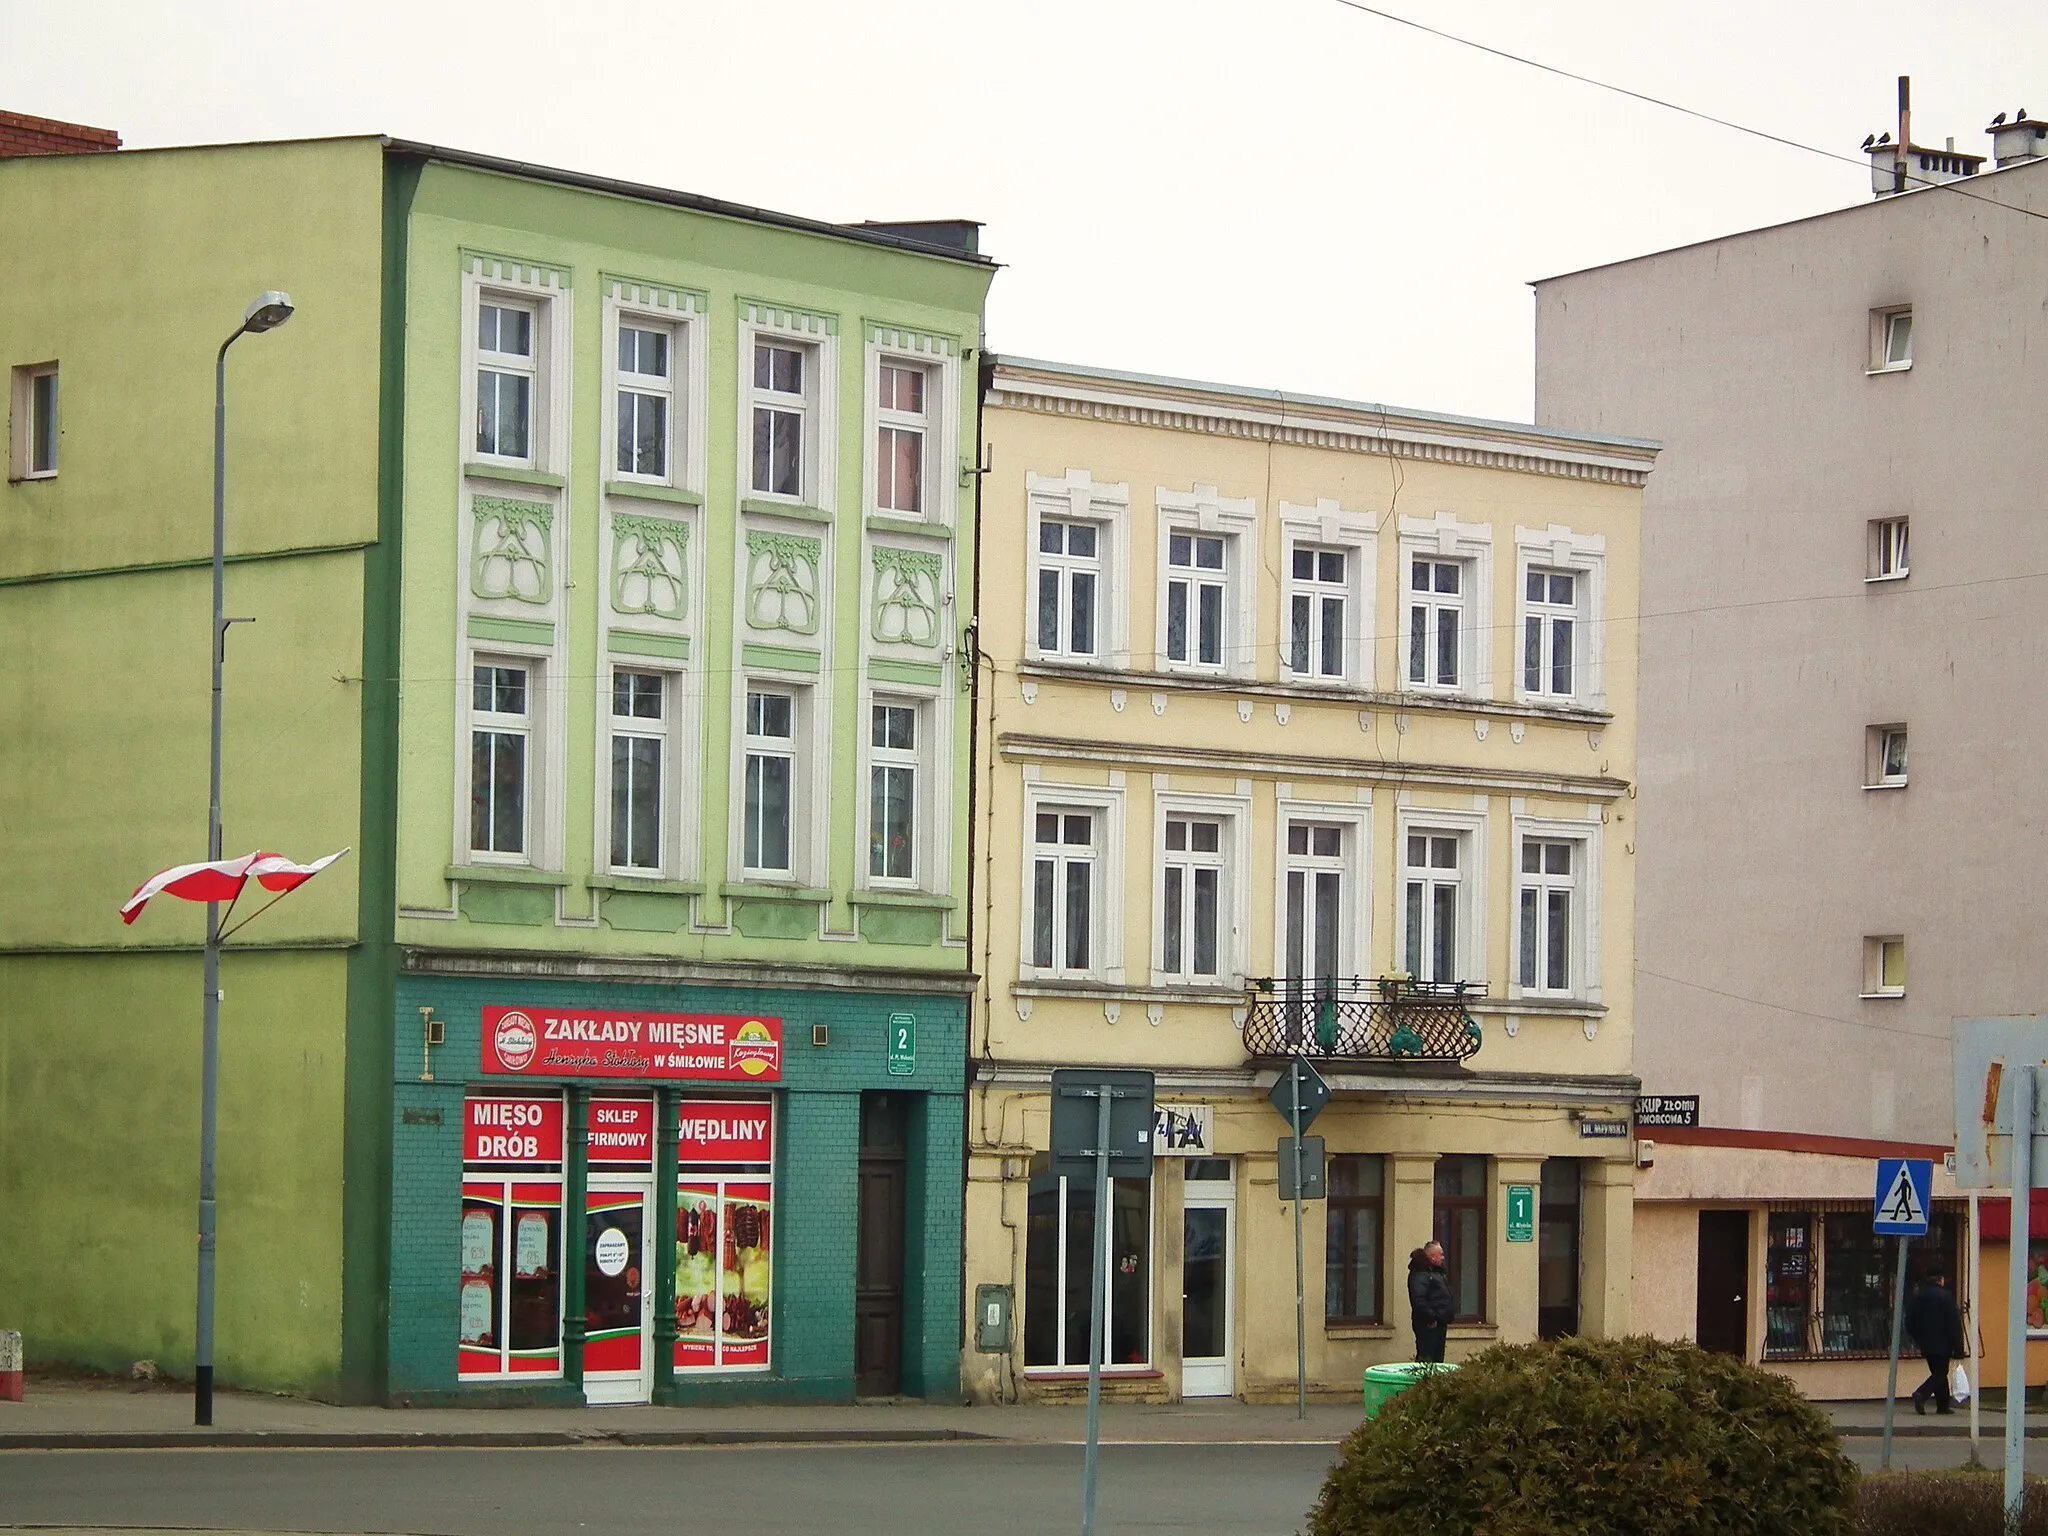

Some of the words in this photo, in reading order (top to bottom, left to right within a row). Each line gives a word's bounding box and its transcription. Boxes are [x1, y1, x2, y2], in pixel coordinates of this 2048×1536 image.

[544, 1018, 642, 1042] ZAKŁADY
[648, 1022, 725, 1049] MIĘSNE
[898, 1028, 908, 1050] 2
[542, 1047, 598, 1072] Henryka
[602, 1049, 650, 1073] Stokłosy
[654, 1054, 666, 1067] W
[667, 1052, 725, 1069] ŚMIŁOWIE
[1634, 1098, 1661, 1113] SKUP
[1664, 1100, 1695, 1111] ZŁOMU
[473, 1103, 543, 1130] MIĘSO
[597, 1109, 639, 1124] SKLEP
[1639, 1114, 1682, 1125] DWORCOWA
[1684, 1112, 1691, 1125] 5
[588, 1132, 647, 1147] FIRMOWY
[678, 1119, 767, 1145] WĘDLINY
[477, 1132, 538, 1158] DRÓB
[1516, 1199, 1524, 1218] 1
[682, 1344, 705, 1352] WYBIERZ
[722, 1345, 730, 1353] CO
